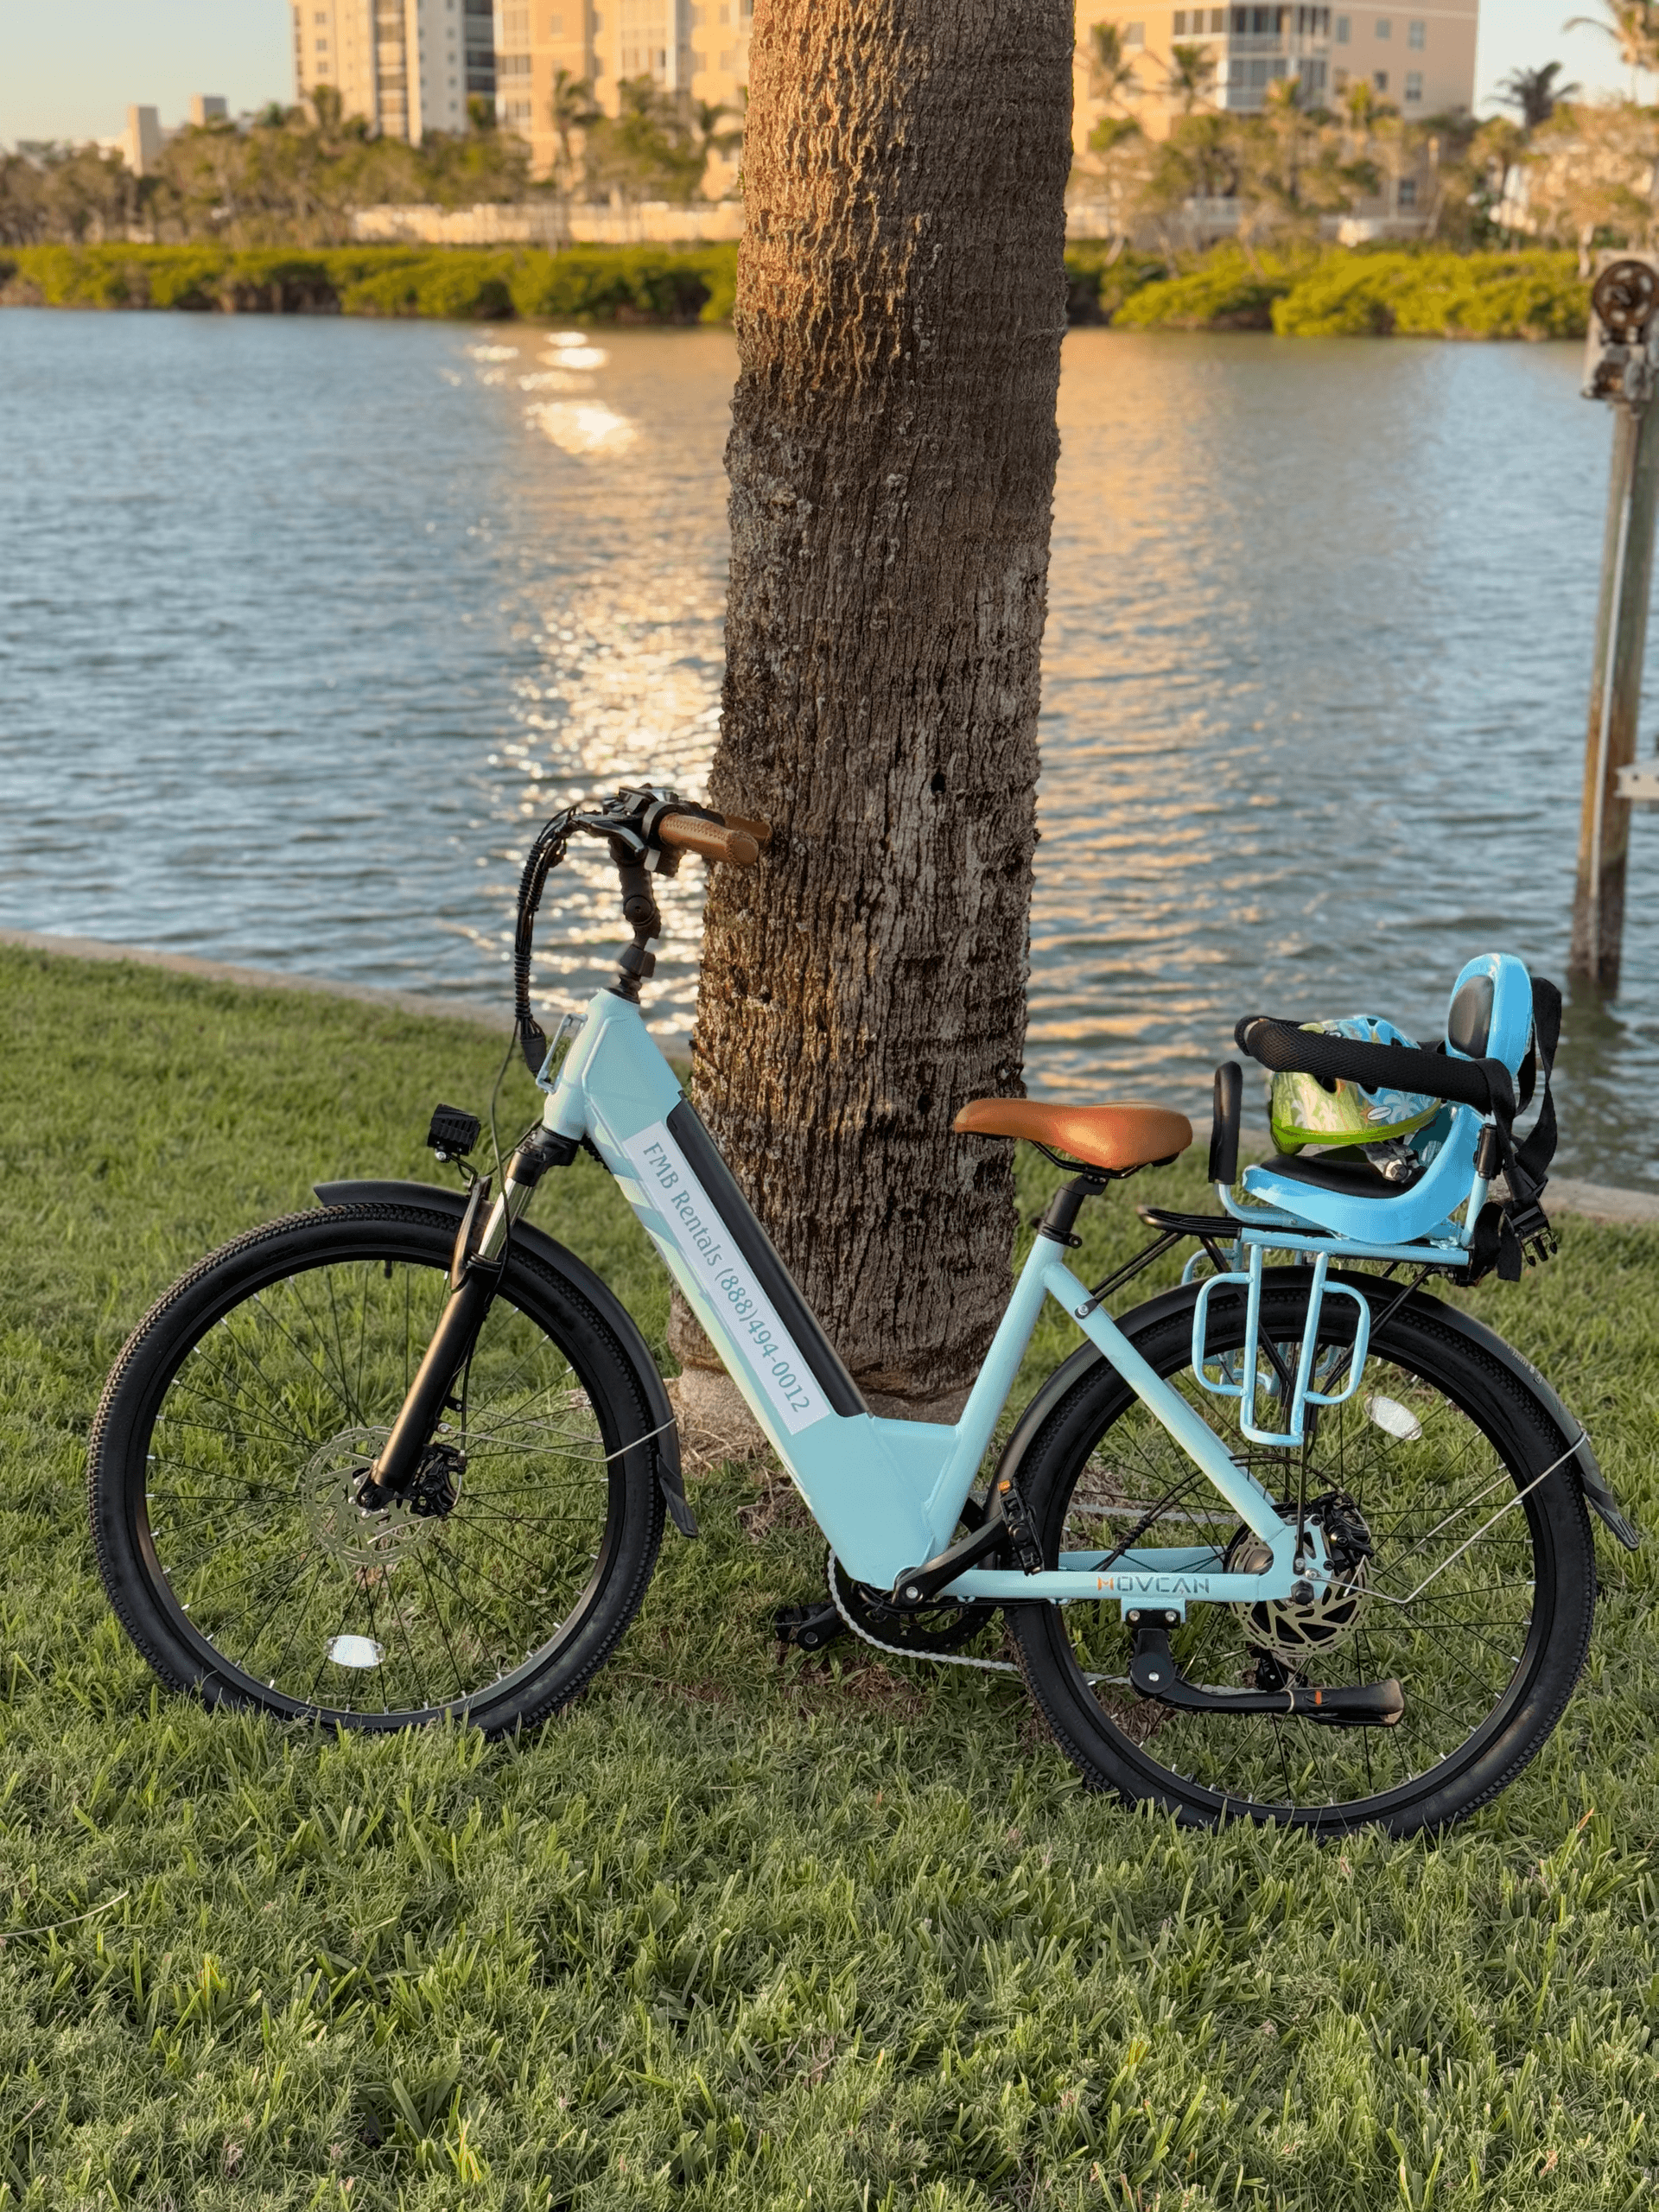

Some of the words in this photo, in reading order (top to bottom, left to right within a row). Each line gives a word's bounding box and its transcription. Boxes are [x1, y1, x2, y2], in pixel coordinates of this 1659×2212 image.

[643, 1142, 679, 1190] FMB
[671, 1190, 723, 1267] Rentals
[714, 1268, 810, 1413] (888)494-0012
[1096, 1576, 1210, 1594] MOVCAN
